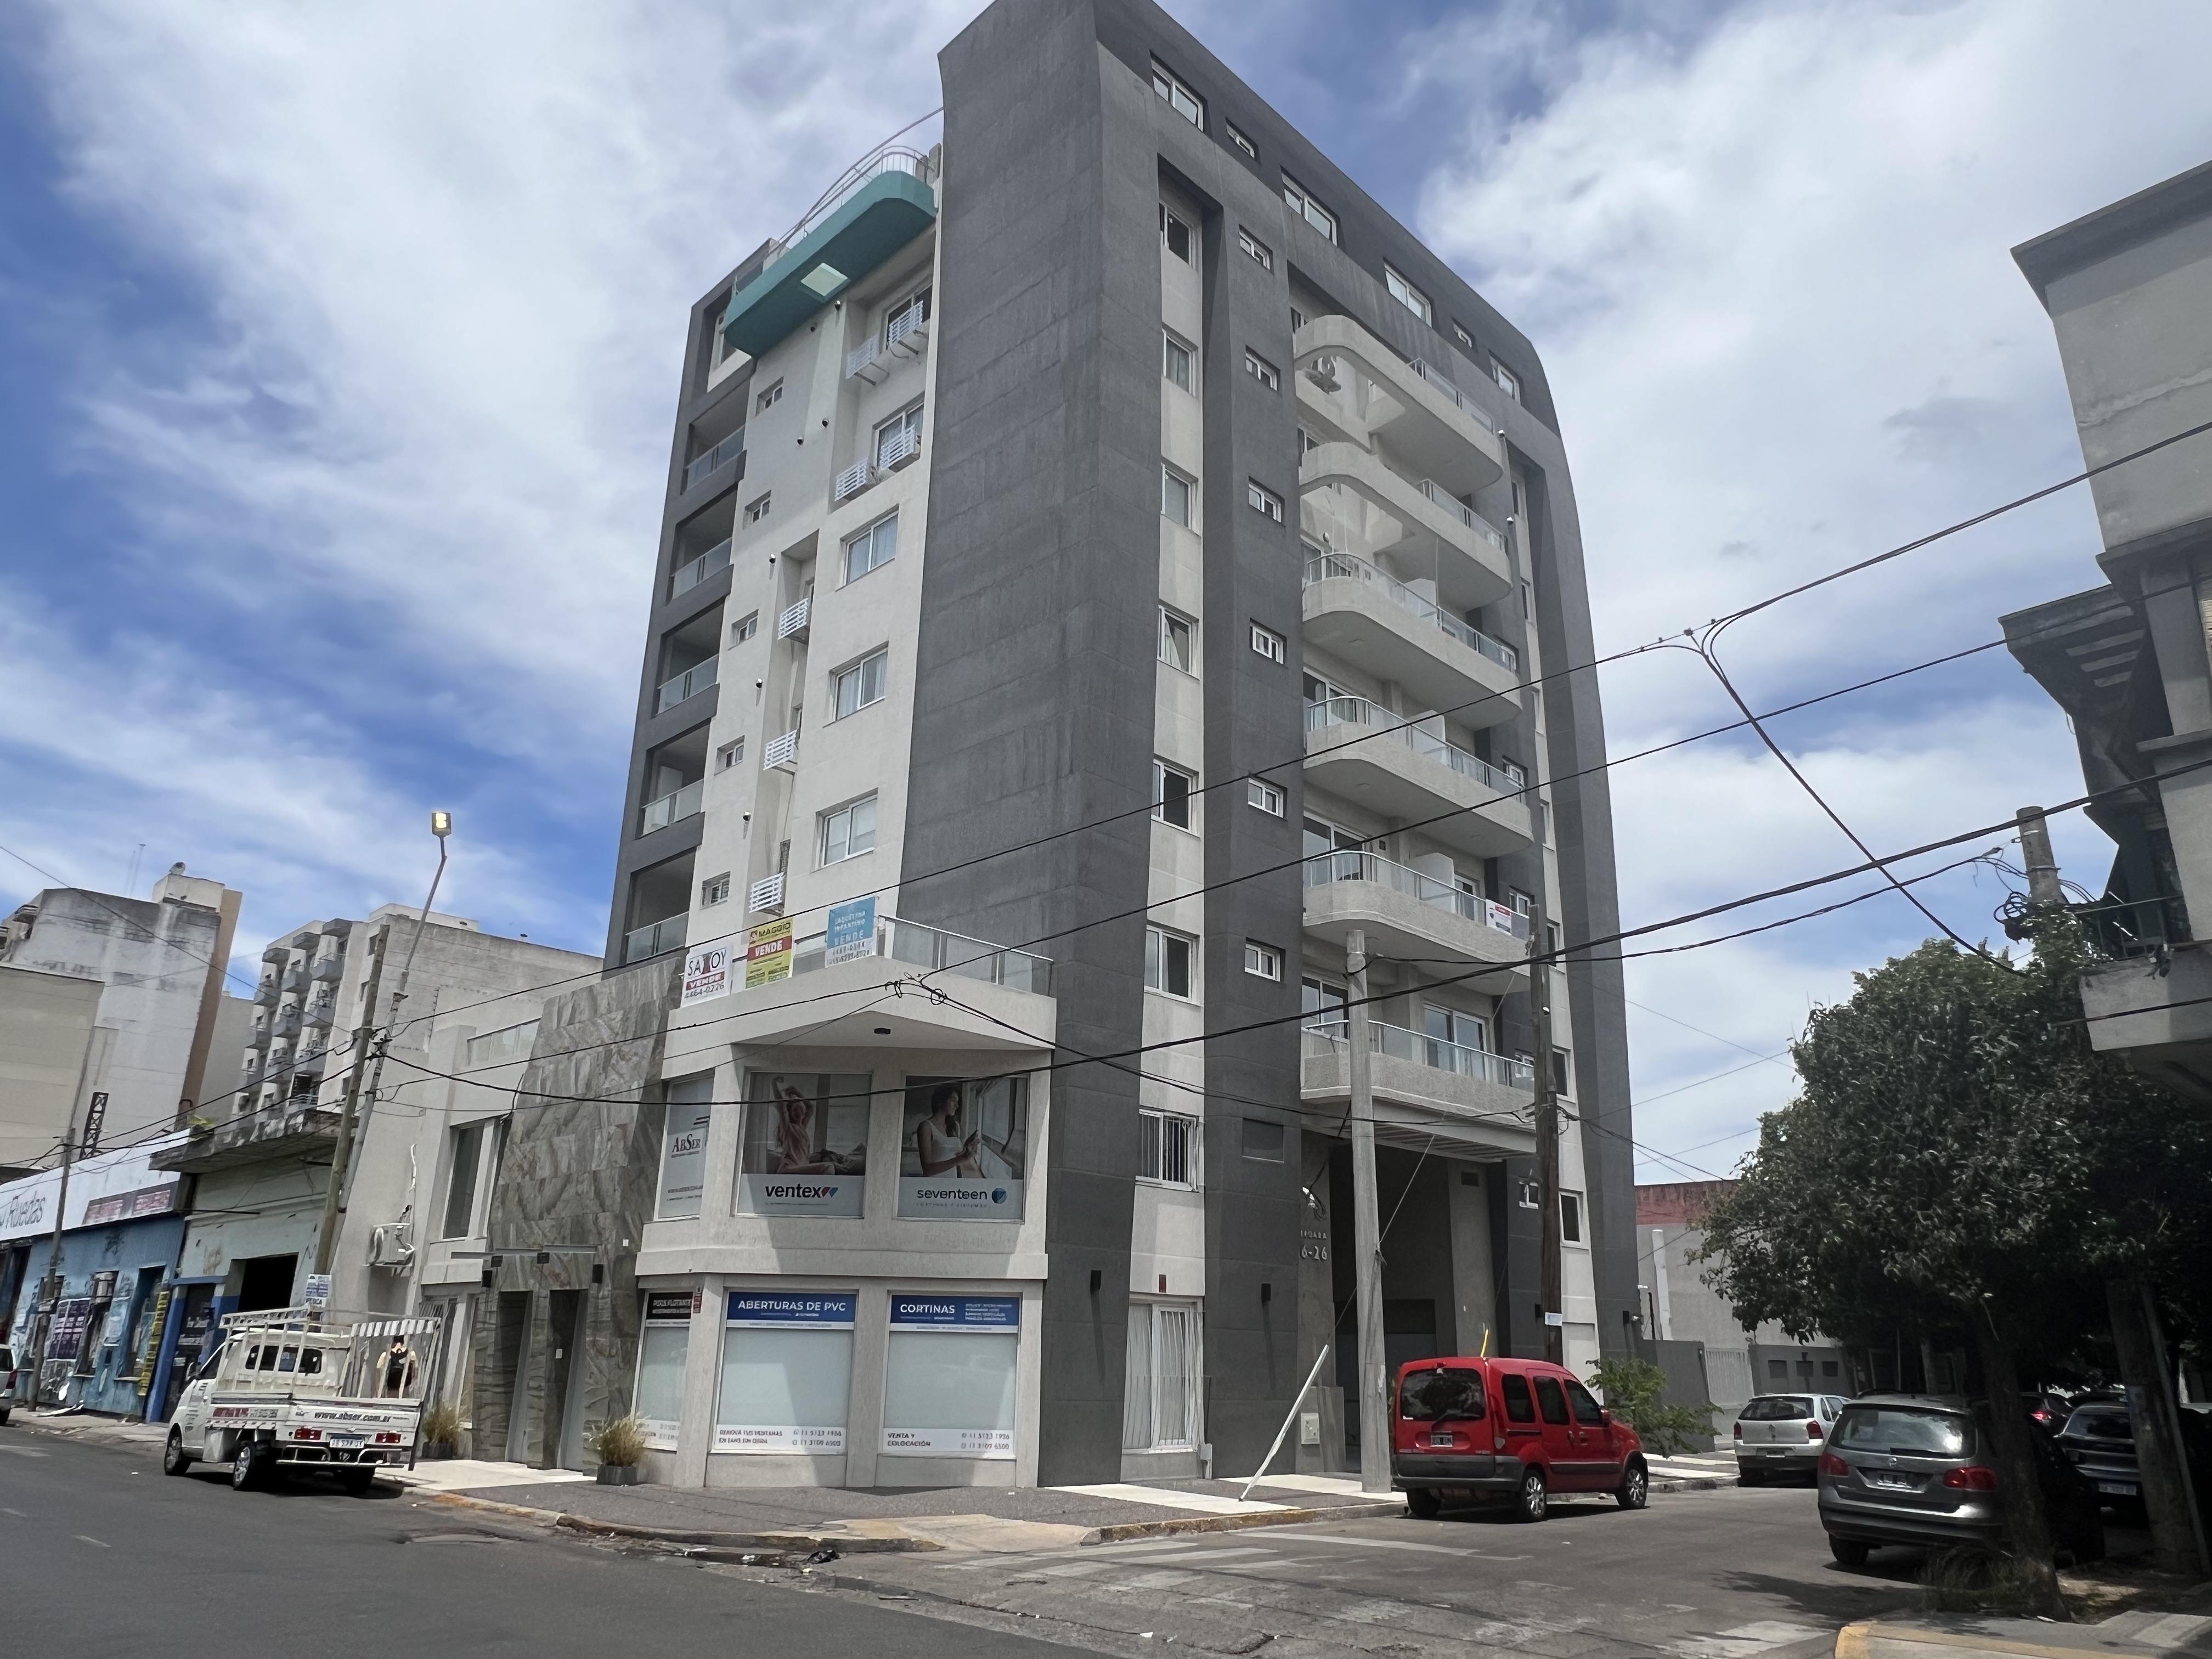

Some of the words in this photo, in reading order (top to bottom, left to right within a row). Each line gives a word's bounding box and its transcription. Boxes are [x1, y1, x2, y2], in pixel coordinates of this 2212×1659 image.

[834, 930, 864, 946] VENDE
[755, 940, 783, 957] VENDE
[765, 1183, 821, 1198] ventex
[917, 1188, 988, 1200] seventeen
[738, 1300, 804, 1311] ABERTURAS
[806, 1302, 821, 1311] DE
[824, 1302, 846, 1311] PVC
[900, 1304, 955, 1314] CORTINAS
